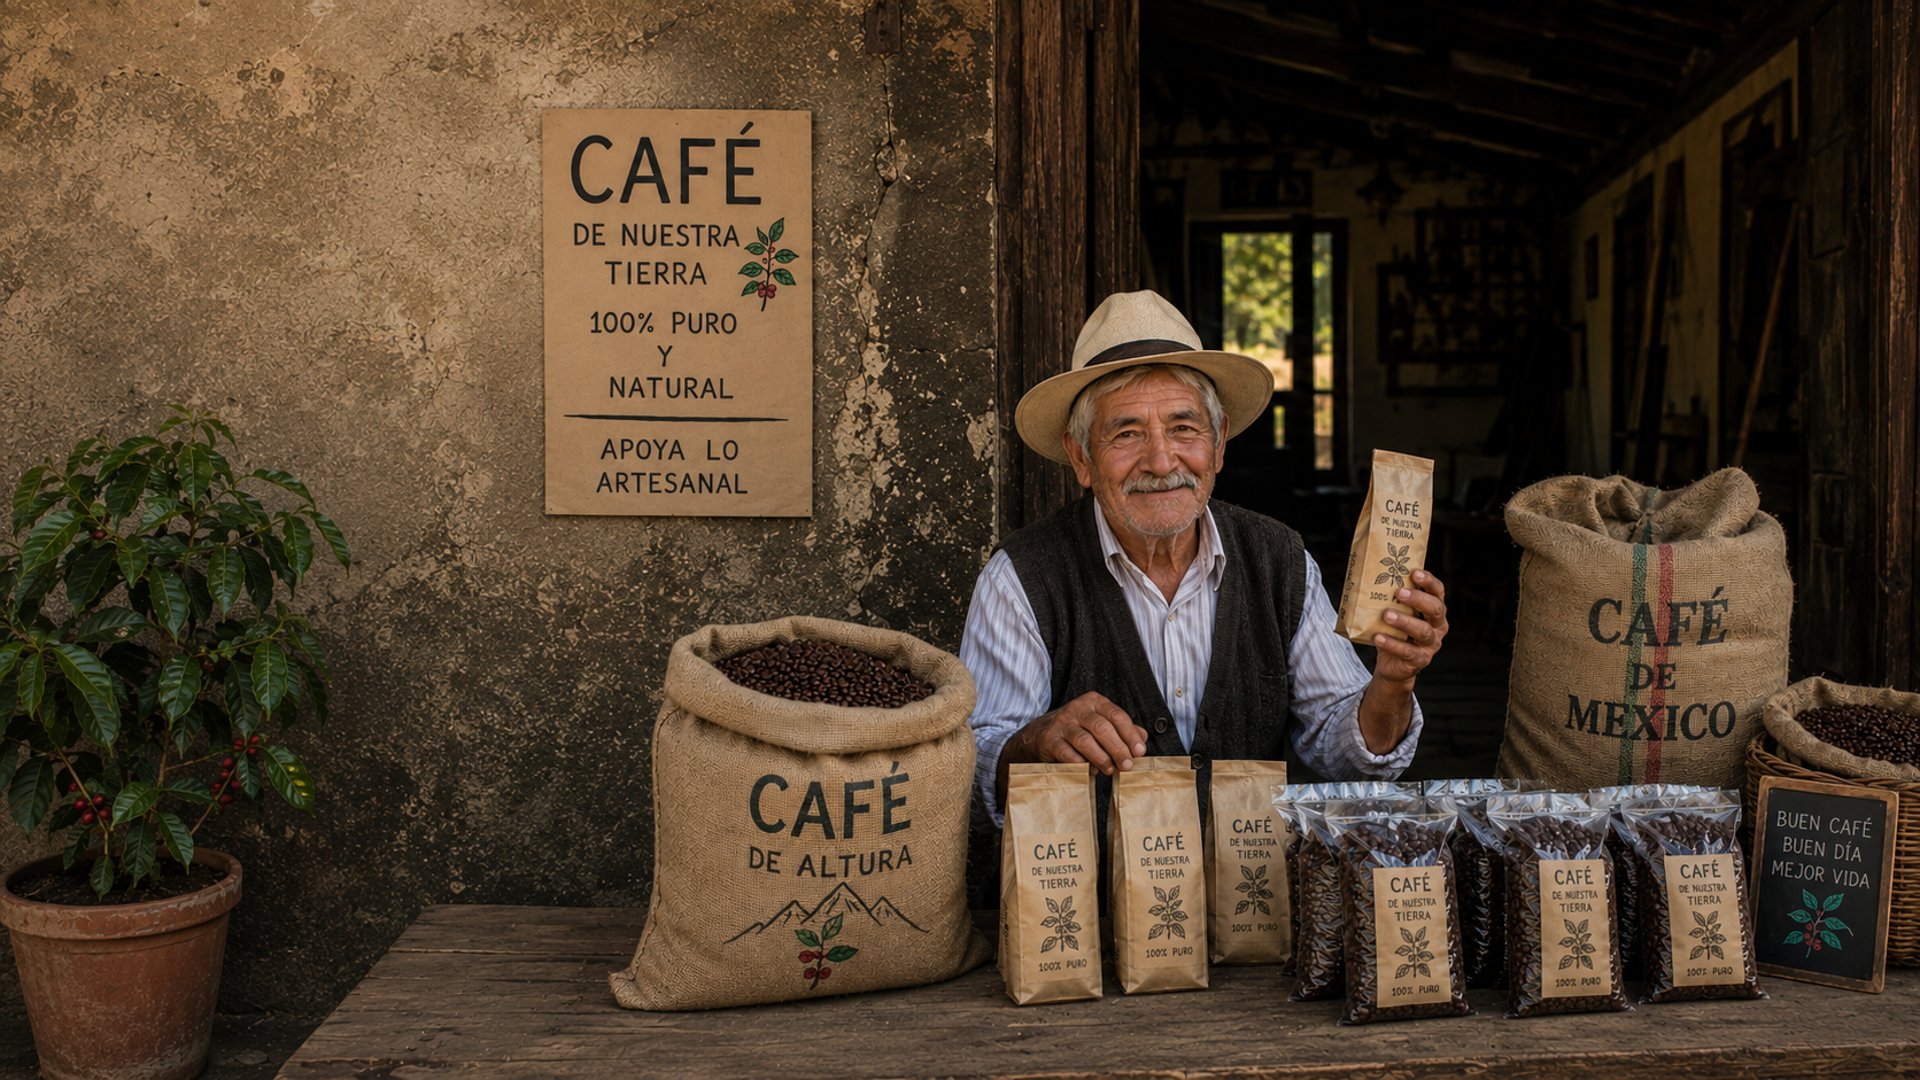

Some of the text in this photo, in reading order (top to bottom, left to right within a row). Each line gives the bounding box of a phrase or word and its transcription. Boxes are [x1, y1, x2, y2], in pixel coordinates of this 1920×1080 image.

[571, 122, 761, 204] CAFÉ
[574, 223, 739, 247] DE NUESTRA
[605, 261, 706, 285] TIERRA
[590, 312, 737, 334] 100% PURO
[658, 346, 672, 367] Y
[610, 377, 733, 399] NATURAL
[601, 439, 739, 461] APOYA LO
[596, 472, 748, 494] ARTESANAL
[1386, 500, 1419, 517] CAFÉ
[1589, 586, 1728, 646] CAFÉ
[1630, 663, 1676, 690] DE
[1565, 694, 1736, 740] MEXICO
[749, 761, 911, 840] CAFÉ
[1233, 816, 1272, 833] CAFÉ
[1777, 810, 1872, 839] BUEN CAFÉ
[1034, 838, 1078, 860] CAFÉ
[1143, 832, 1184, 851] CAFÉ
[1230, 838, 1277, 846] DE NUESTRA
[1783, 836, 1861, 862] BUEN DÍA
[749, 845, 912, 877] DE ALTURA
[1141, 856, 1190, 866] DE NUESTRA
[1237, 850, 1271, 859] TIERRA
[1032, 864, 1084, 876] DE NUESTRA
[1148, 868, 1184, 879] TIERRA
[1555, 866, 1593, 885] CAFÉ
[1680, 860, 1721, 878] CAFÉ
[1772, 860, 1870, 889] MEJOR VIDA
[1040, 878, 1077, 890] TIERRA
[1391, 872, 1431, 893] CAFÉ
[1679, 884, 1727, 893] DE NUESTRA
[1388, 898, 1436, 908] DE NUESTRA
[1552, 890, 1598, 900] DE NUESTRA
[1687, 896, 1721, 905] TIERRA
[1395, 911, 1431, 921] TIERRA
[1560, 903, 1592, 912] TIERRA
[1232, 923, 1277, 932] 100% PURO
[1146, 947, 1193, 958] 100% PURO
[1039, 959, 1087, 972] 100% PURO
[1687, 967, 1733, 976] 100% PURO
[1392, 985, 1439, 996] 100% PURO
[1555, 977, 1601, 987] 100% PURO
